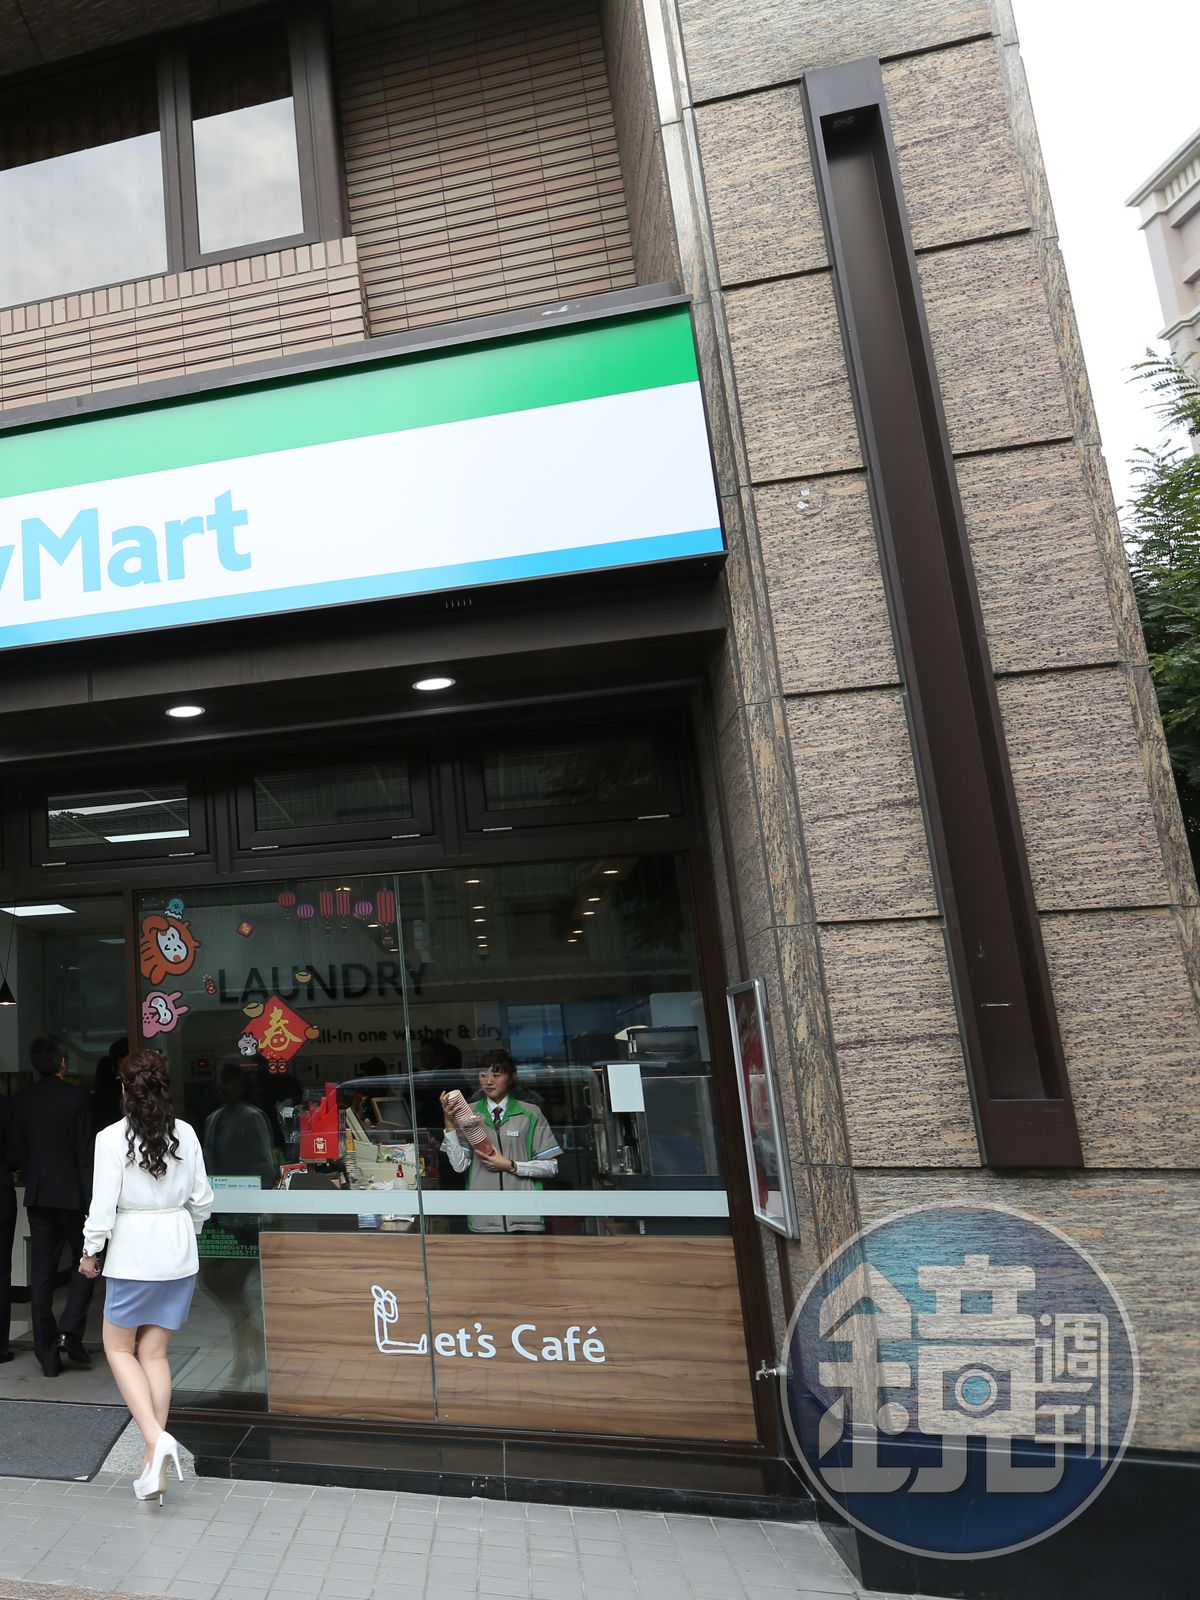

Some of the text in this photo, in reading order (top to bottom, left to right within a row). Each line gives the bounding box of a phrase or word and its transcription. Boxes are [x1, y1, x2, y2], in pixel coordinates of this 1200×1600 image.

[218, 960, 430, 1005] LAUNDRY
[257, 1007, 303, 1052] 春
[311, 1029, 353, 1044] ll-in
[358, 1030, 387, 1042] one
[394, 1026, 451, 1042] washer
[511, 1322, 607, 1365] Café
